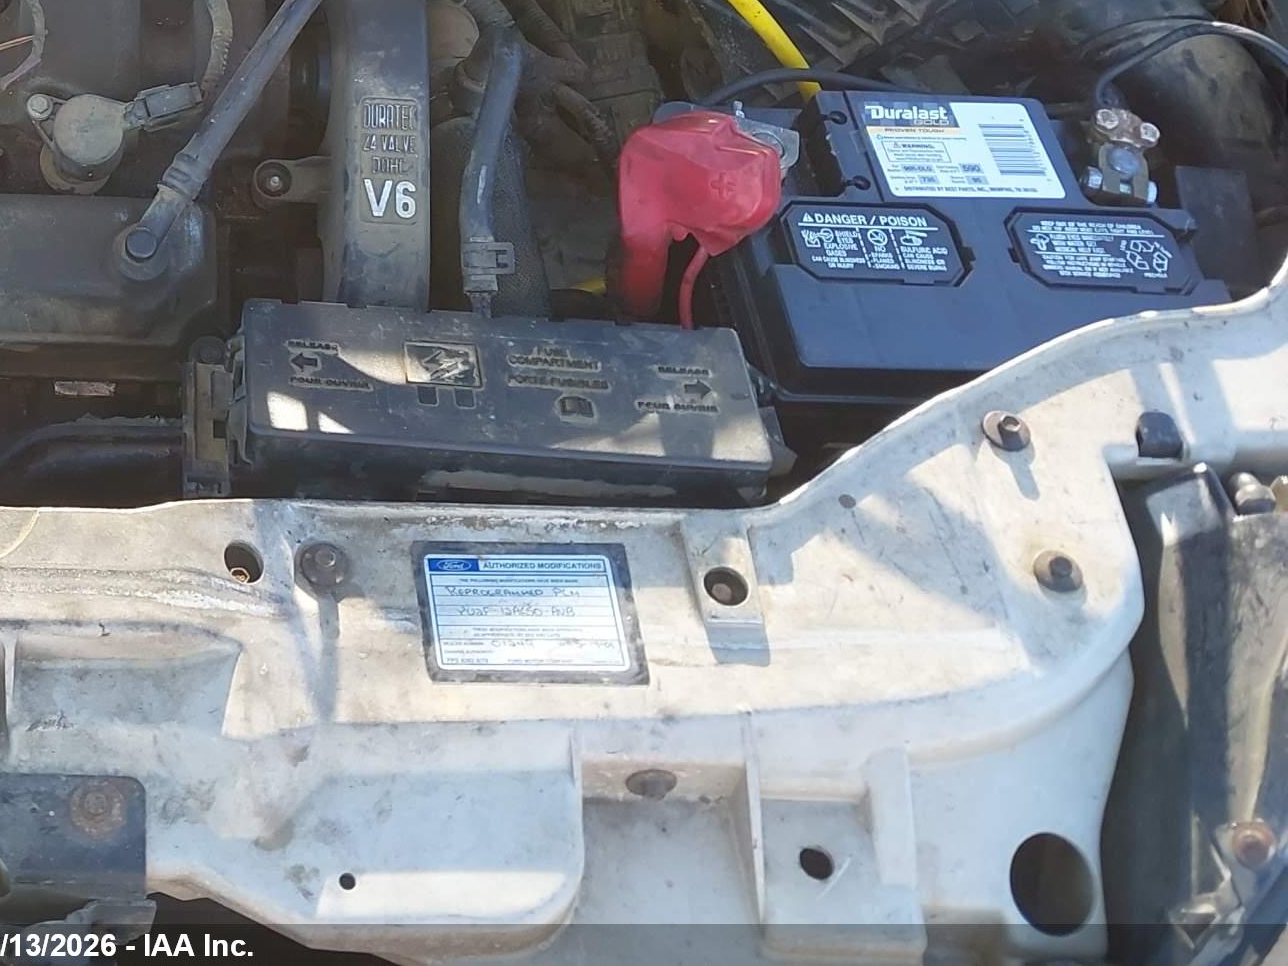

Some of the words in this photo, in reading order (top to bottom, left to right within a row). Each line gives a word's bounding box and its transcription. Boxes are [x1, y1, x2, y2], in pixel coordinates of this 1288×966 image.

[363, 104, 416, 130] DURATEC
[864, 105, 948, 120] Duralast
[382, 135, 416, 153] VALVE
[363, 178, 416, 219] V6
[814, 213, 867, 225] DANGER
[869, 216, 876, 225] /
[879, 216, 927, 227] POISON
[509, 355, 600, 370] COMPARTMENT
[444, 560, 465, 570] Ford
[482, 561, 536, 570] AUTHORIZED
[537, 562, 602, 570] MODIFICATIONS
